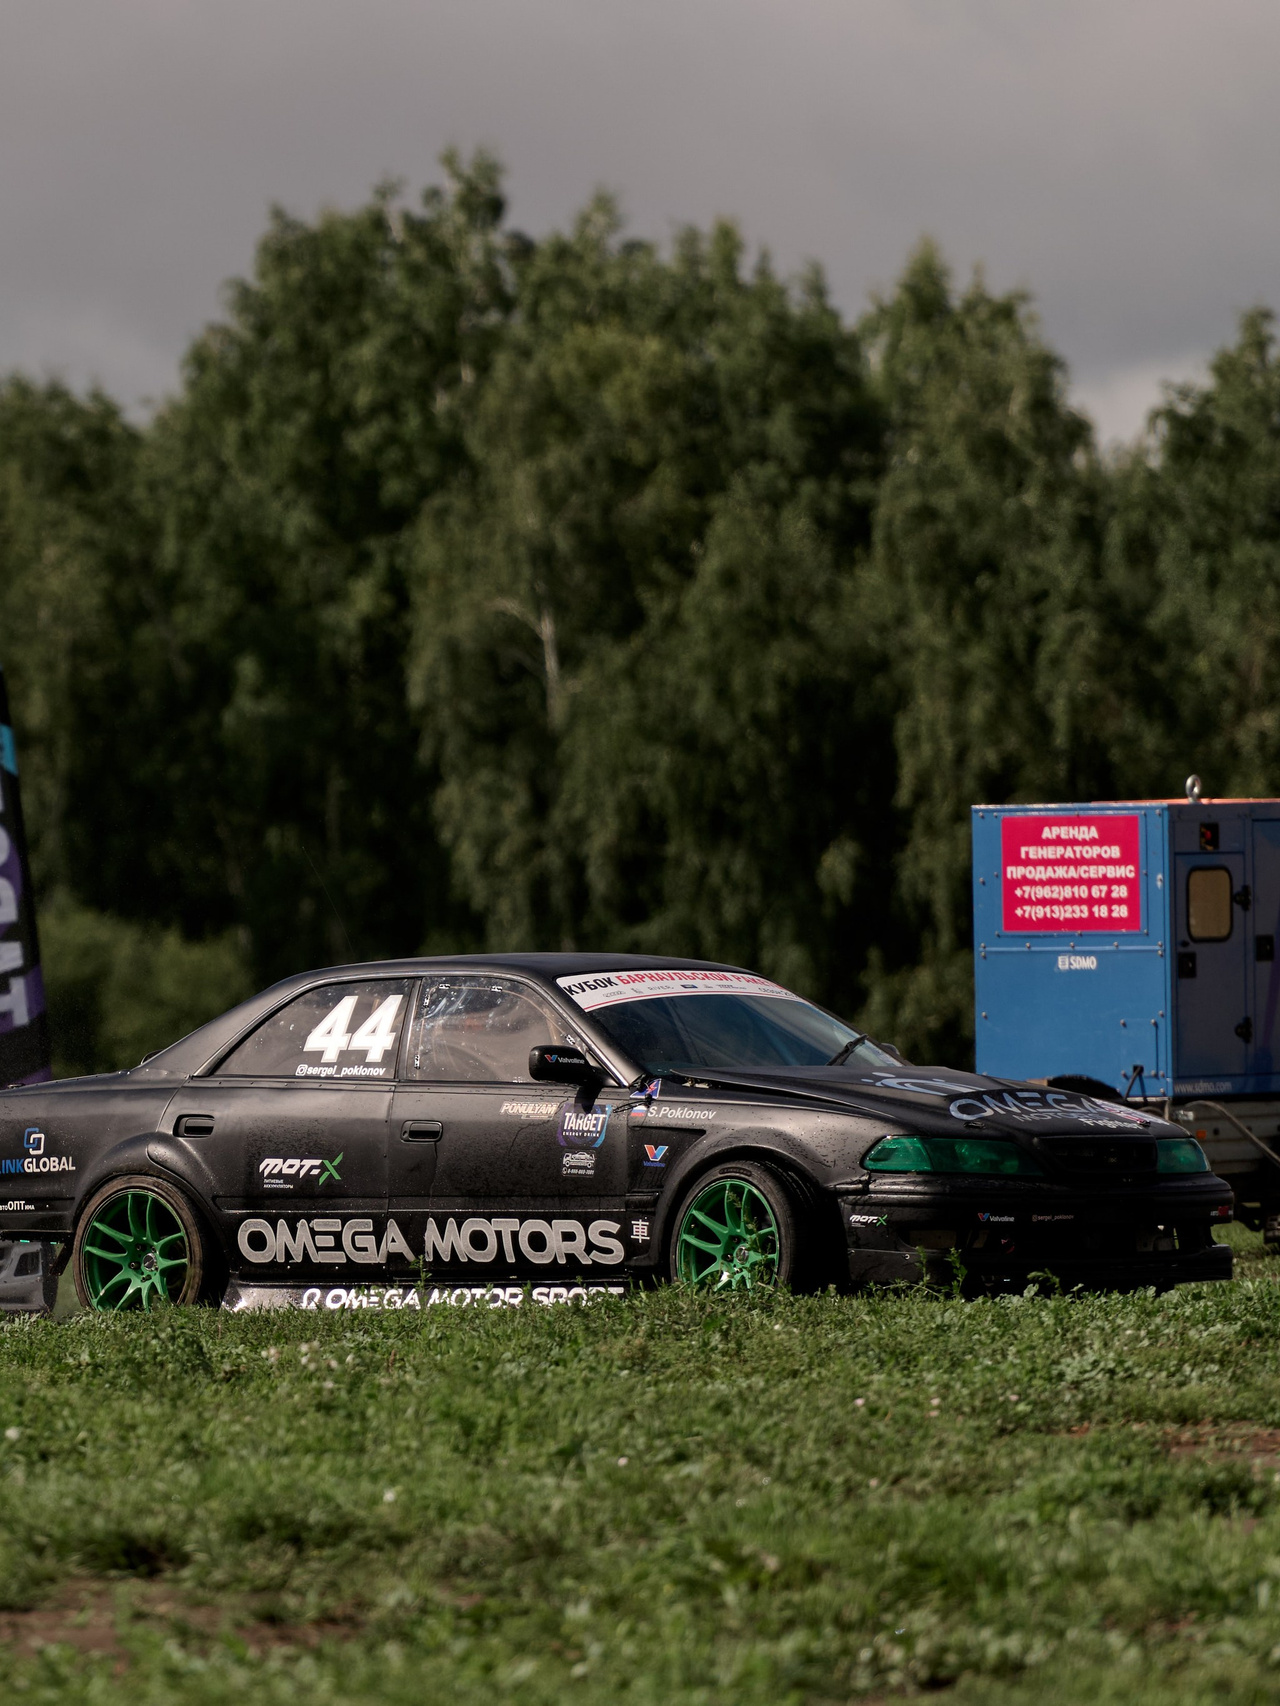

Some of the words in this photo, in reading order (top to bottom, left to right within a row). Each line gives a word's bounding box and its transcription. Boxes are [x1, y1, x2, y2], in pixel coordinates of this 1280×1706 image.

[1041, 825, 1099, 841] АРЕНДА
[1020, 845, 1121, 860] ГЕНЕРАТОРОВ
[1006, 865, 1136, 881] ПРОДАЖА/СЕРВИС
[1091, 885, 1108, 899] 67
[1111, 885, 1128, 899] 28
[1014, 904, 1089, 921] +7(913)233
[1092, 904, 1109, 918] 18
[1111, 904, 1128, 918] 28
[1070, 955, 1098, 970] SDMO
[563, 976, 619, 996] КУБОК
[615, 971, 733, 985] БАРНАУЛЬСКОЙ
[731, 974, 784, 990] РАКЕ
[303, 994, 404, 1063] 44
[648, 1106, 717, 1120] S.Poklonov
[949, 1091, 1106, 1121] OMEGA
[563, 1112, 608, 1131] TARGET
[630, 1219, 651, 1244] 車
[237, 1218, 417, 1264] OMEGA
[424, 1217, 625, 1265] MOTORS
[325, 1288, 421, 1310] OMEGA
[427, 1287, 524, 1309] MOTOR
